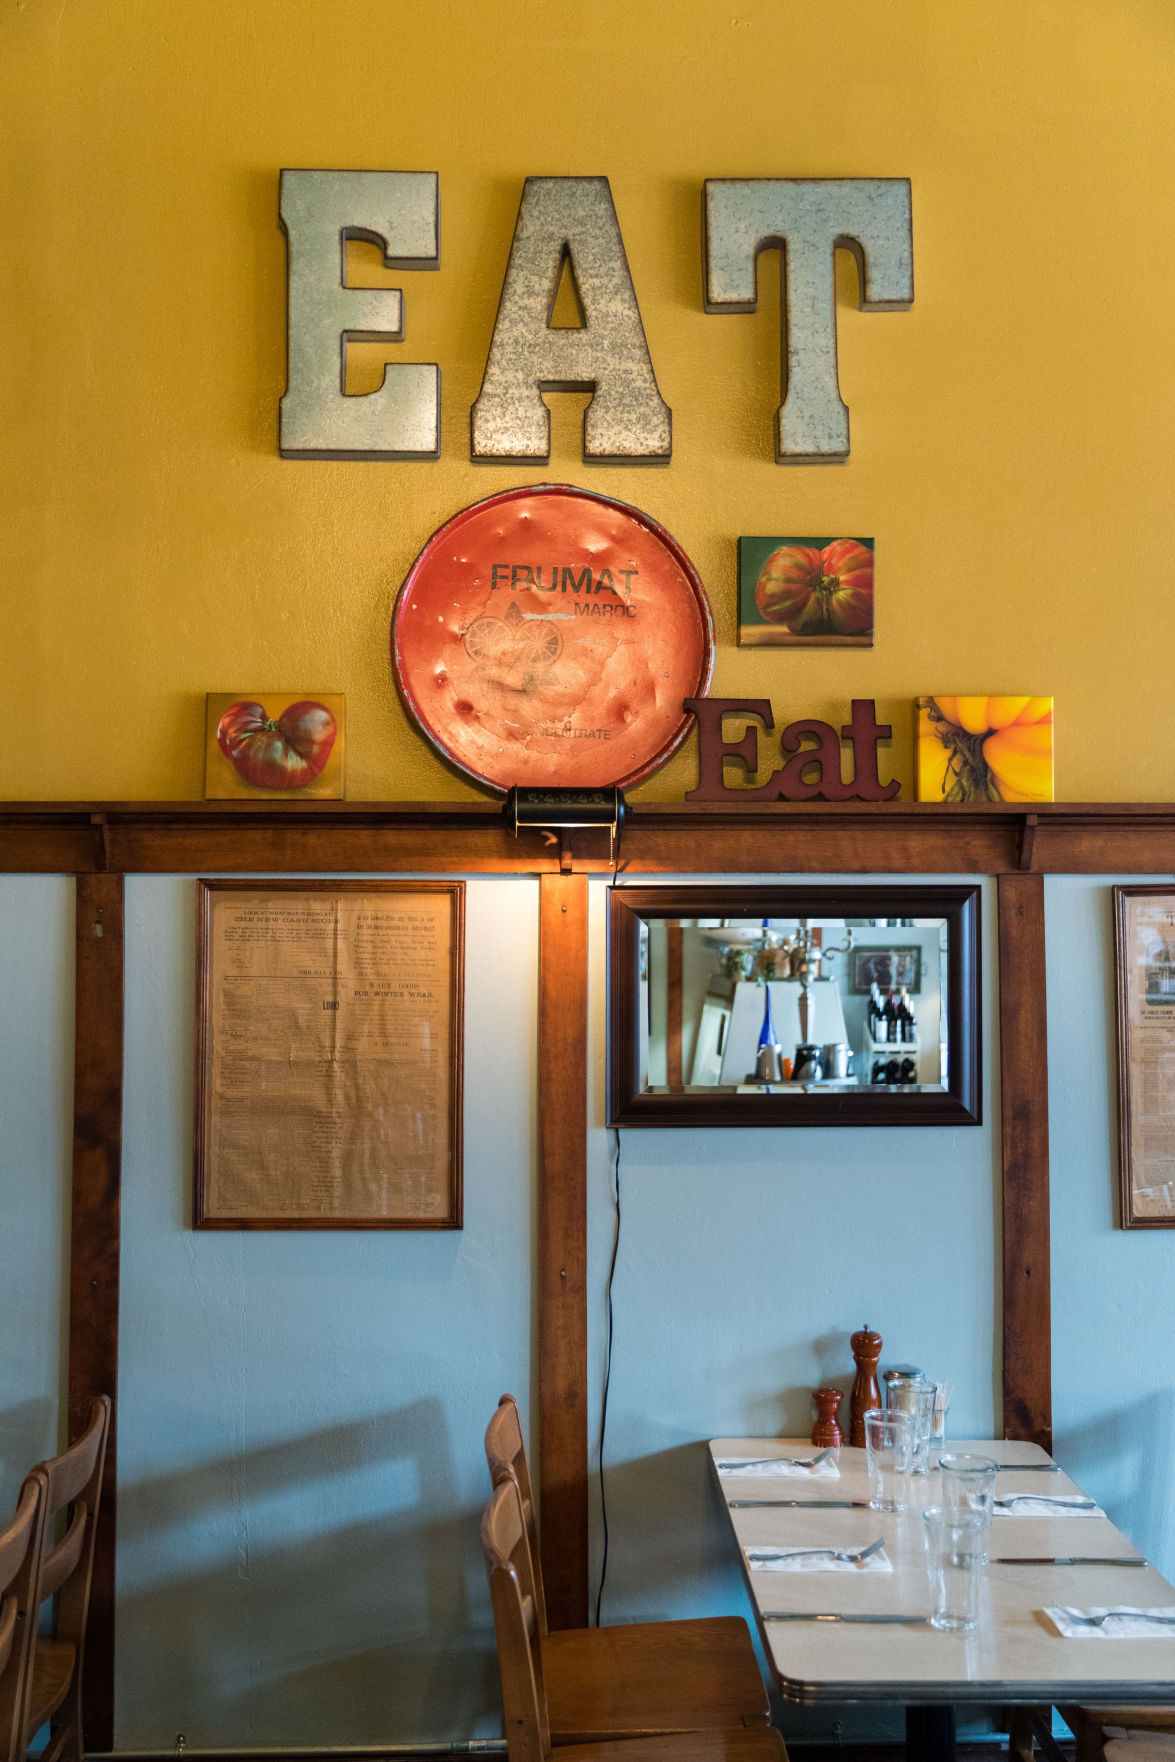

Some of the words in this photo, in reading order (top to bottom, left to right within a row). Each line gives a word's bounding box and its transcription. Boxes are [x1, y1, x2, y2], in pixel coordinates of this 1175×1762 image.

[278, 168, 914, 464] EAT
[491, 563, 639, 596] FRUMAT
[574, 602, 638, 618] MAROC
[683, 698, 901, 801] Eat
